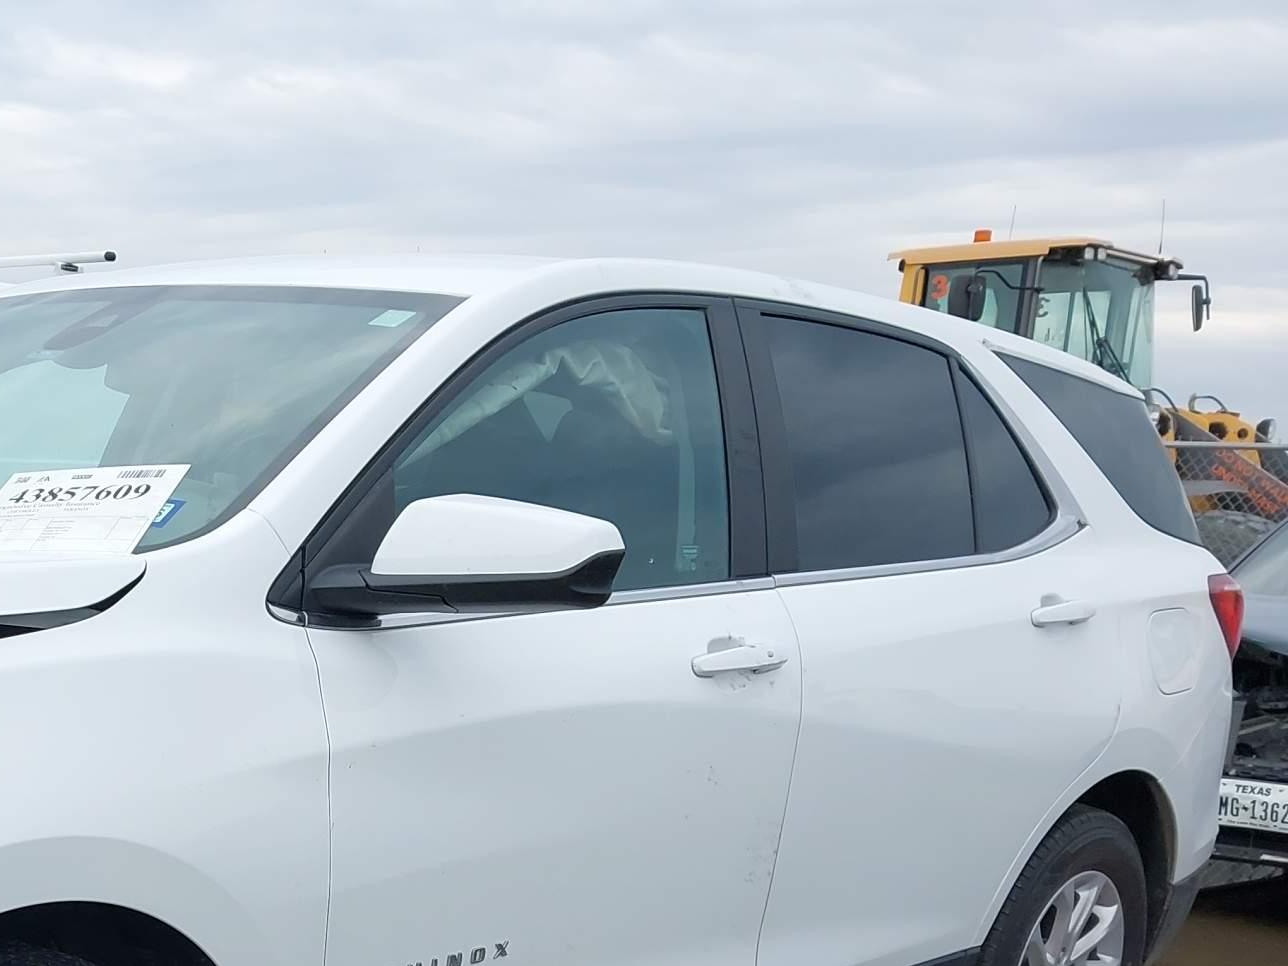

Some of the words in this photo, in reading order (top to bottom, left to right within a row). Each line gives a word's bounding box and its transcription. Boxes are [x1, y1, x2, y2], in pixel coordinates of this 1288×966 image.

[931, 274, 949, 300] 3
[9, 484, 151, 504] 43857609
[1235, 784, 1272, 797] TEXAS
